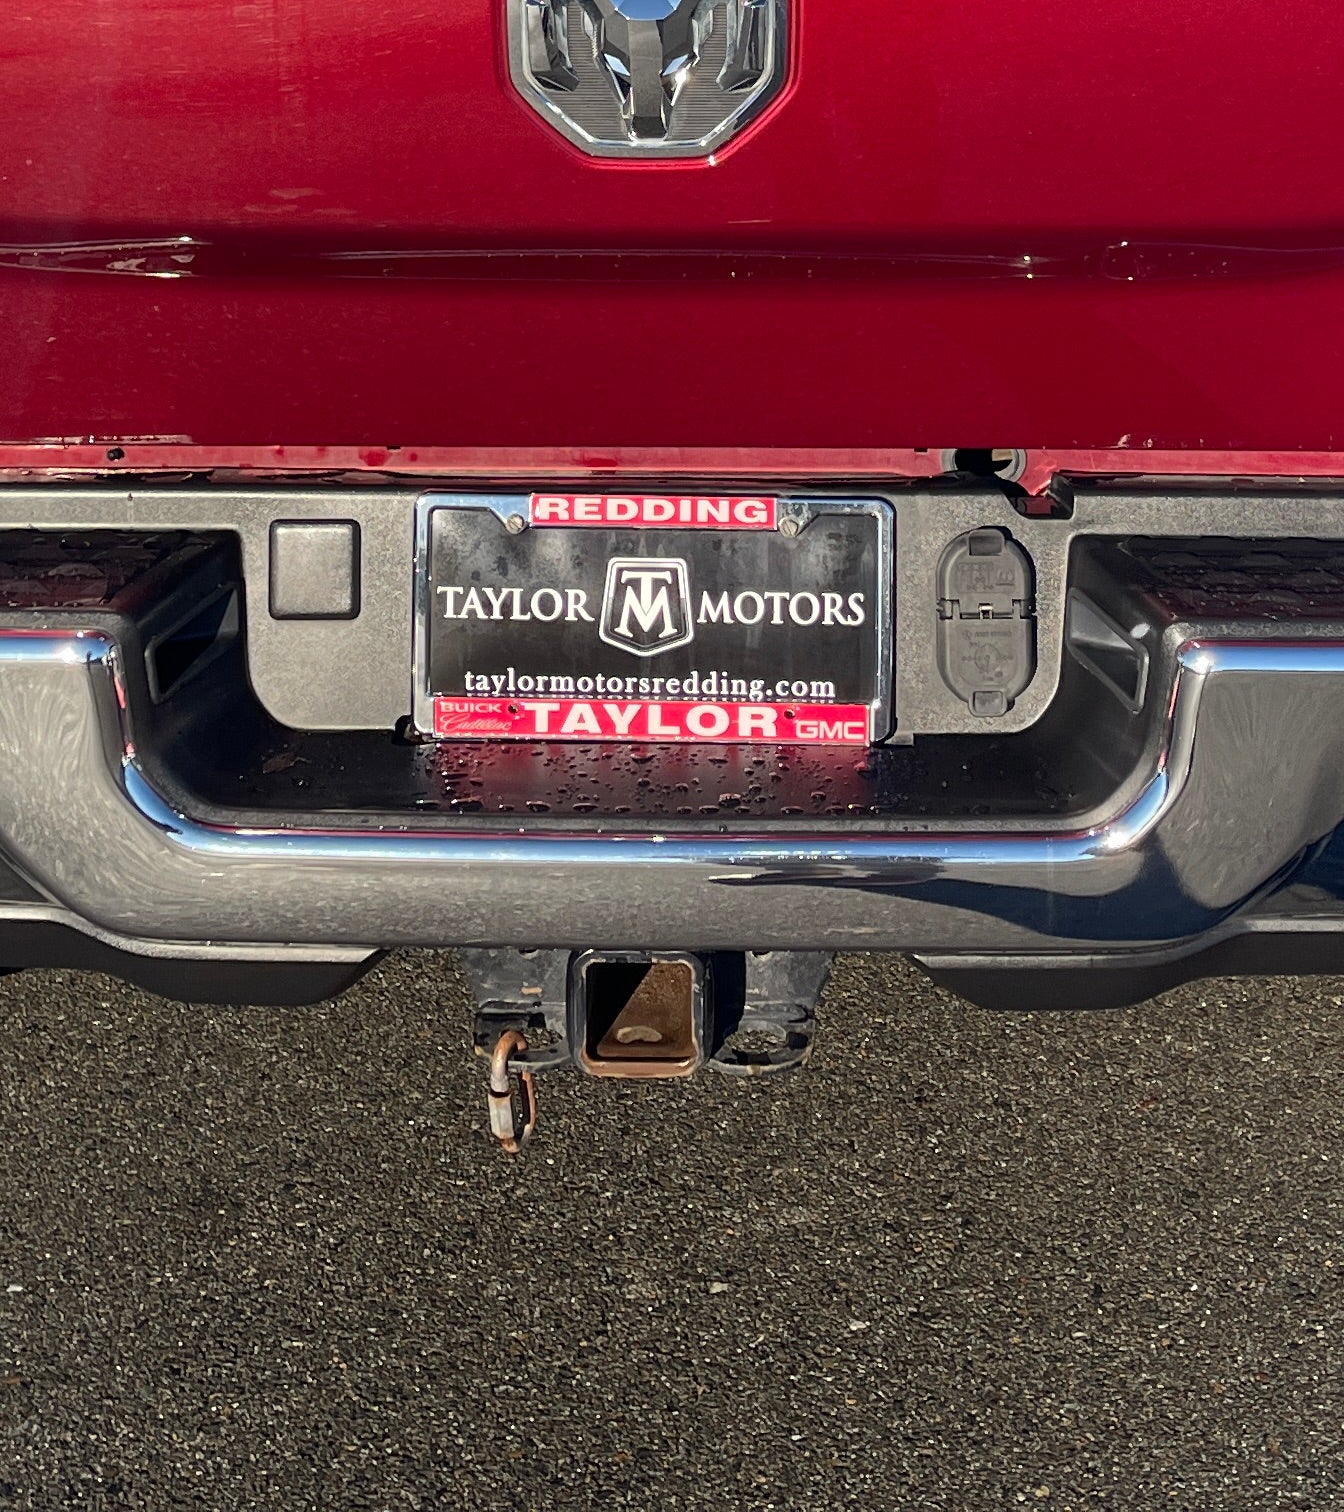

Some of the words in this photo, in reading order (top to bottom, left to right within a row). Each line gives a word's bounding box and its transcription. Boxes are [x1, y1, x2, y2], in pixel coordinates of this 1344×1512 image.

[537, 496, 768, 523] REDDING
[436, 586, 595, 622] TAYLOR
[697, 590, 866, 626] MOTORS
[464, 667, 836, 702] taylormotorsredding.com
[440, 702, 502, 714] BUICK
[441, 713, 513, 731] Cadillac
[523, 703, 778, 737] TAYLOR
[795, 720, 865, 740] GMC
